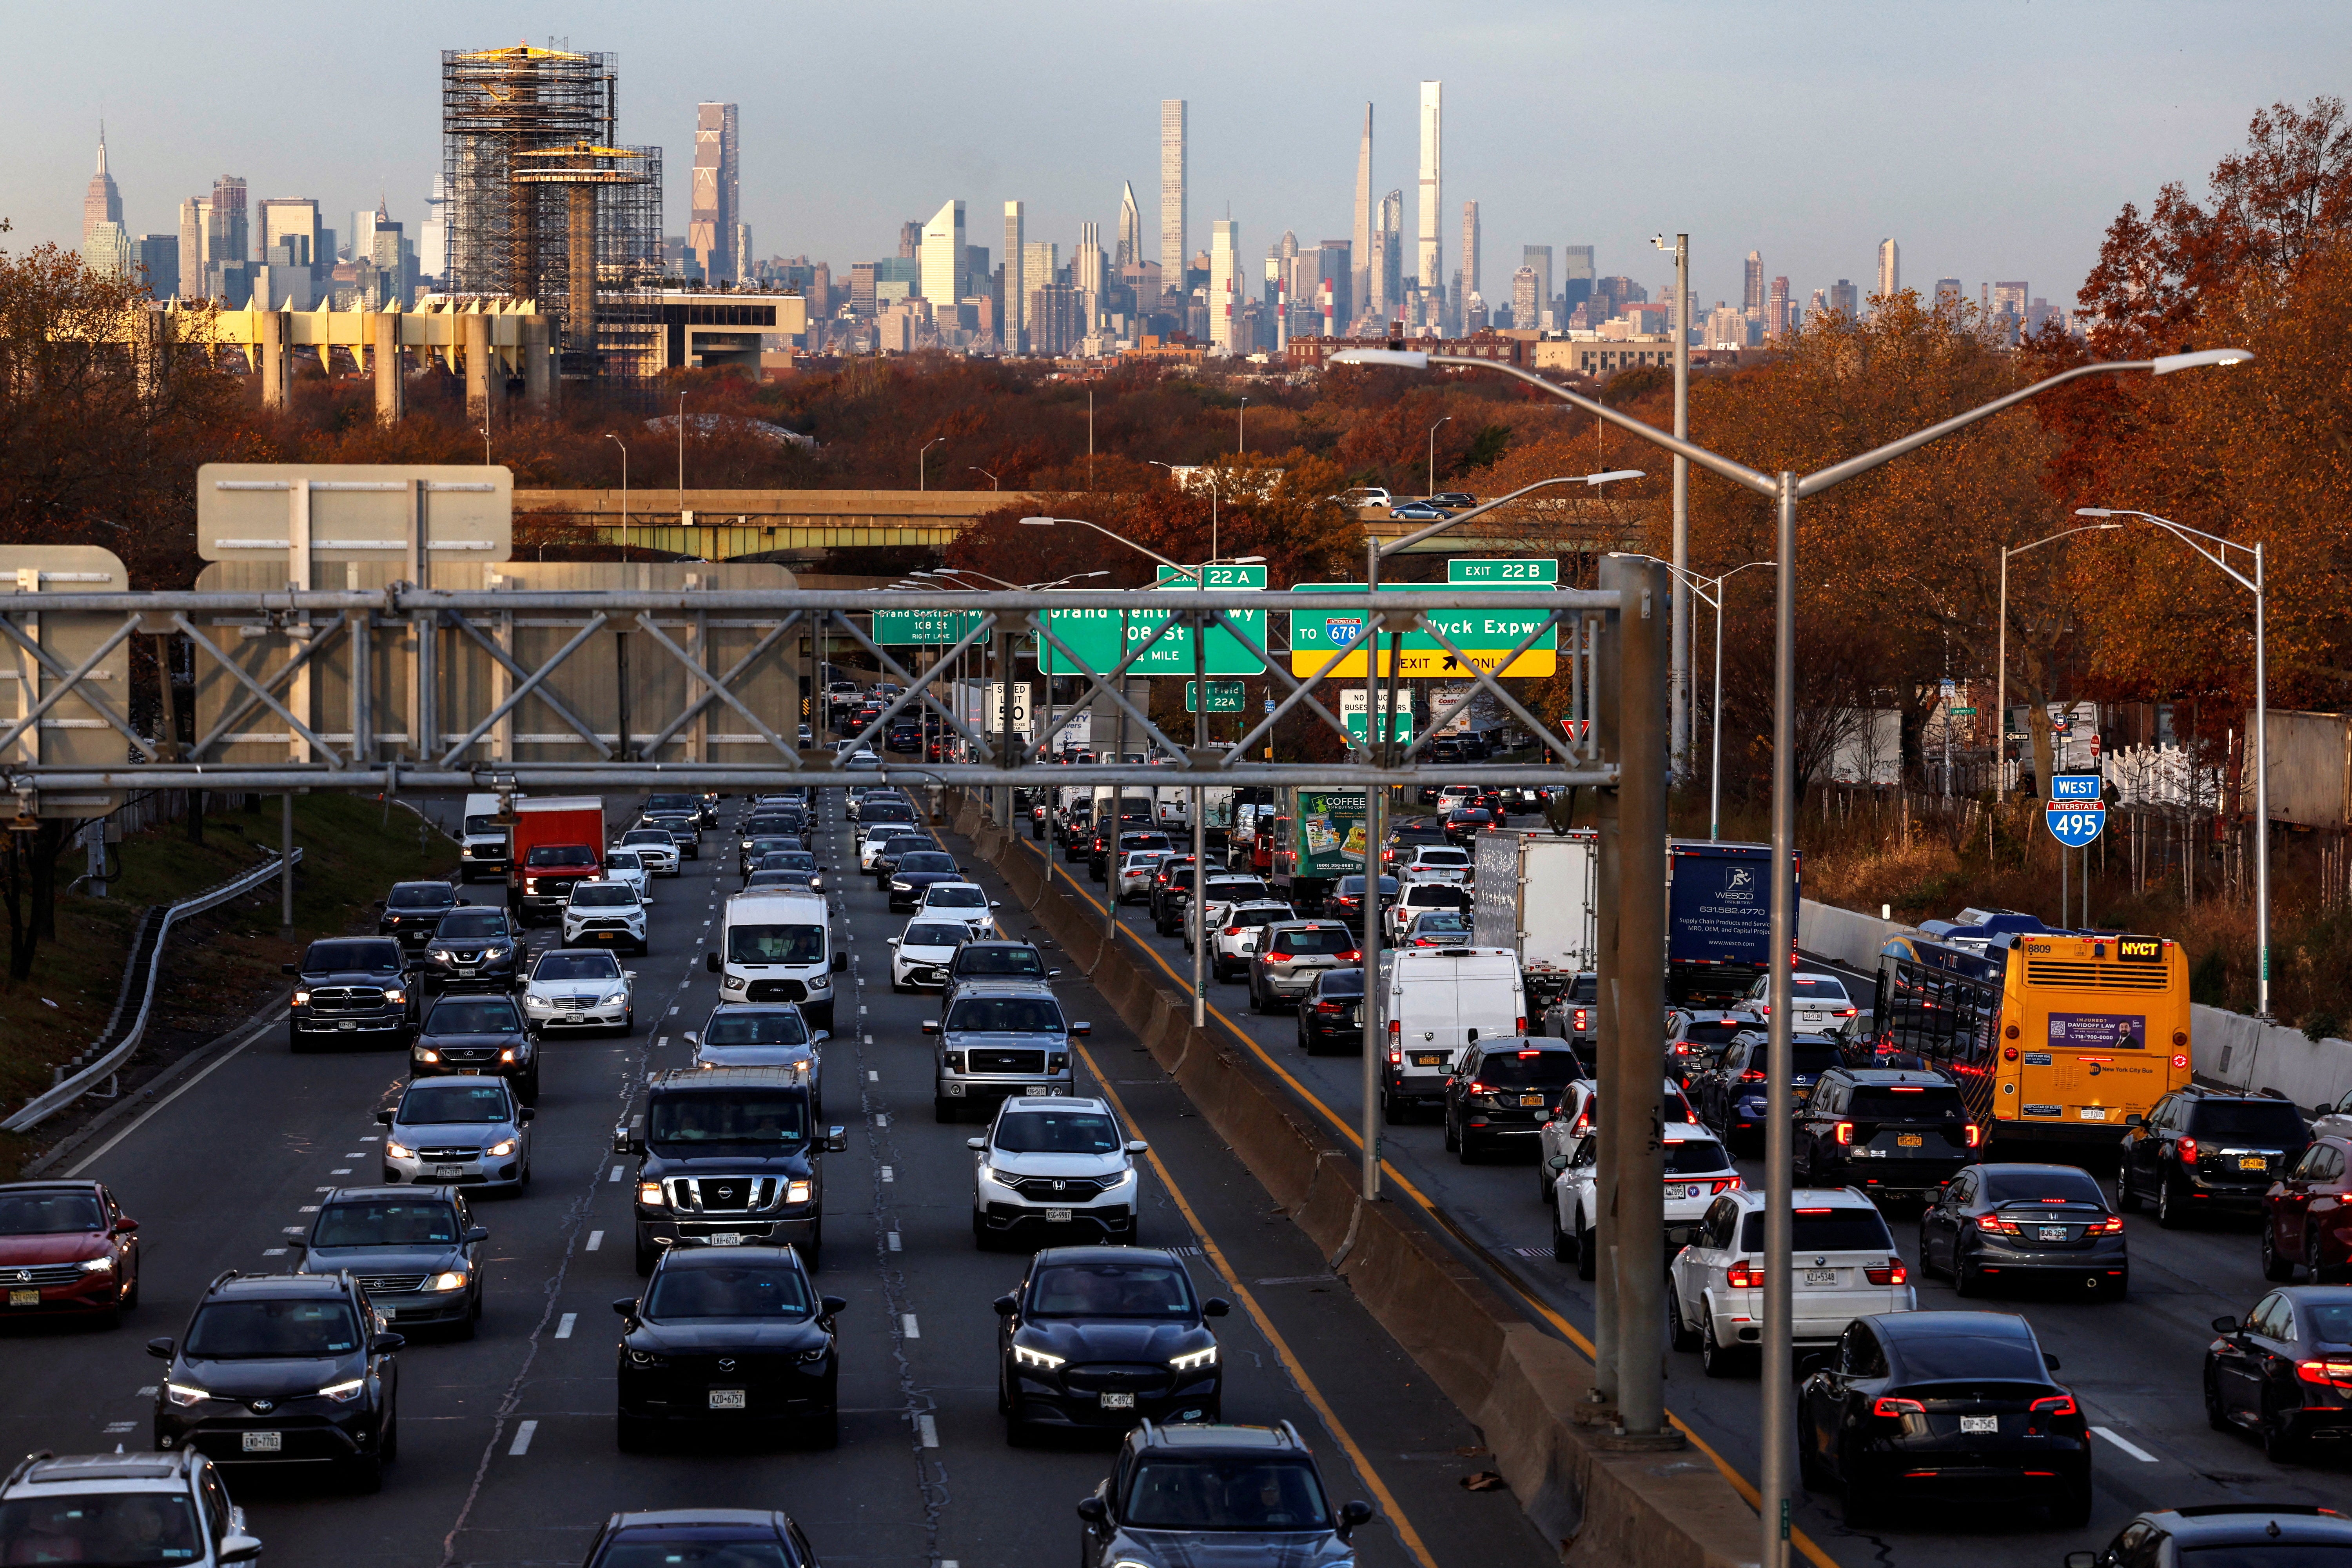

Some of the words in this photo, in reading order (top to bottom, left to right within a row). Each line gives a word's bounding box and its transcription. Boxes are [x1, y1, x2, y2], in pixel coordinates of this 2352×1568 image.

[1466, 566, 1491, 575] EXIT
[1503, 564, 1524, 577] 22
[1529, 564, 1540, 577] B
[1210, 571, 1232, 583] 22
[1238, 571, 1250, 583] A
[1164, 627, 1184, 640] St
[1299, 629, 1317, 639] TO
[1332, 626, 1356, 639] 678
[1152, 652, 1179, 660] MILE
[1401, 658, 1430, 668] EXIT
[2059, 781, 2094, 793] WEST
[1326, 797, 1366, 806] COFFEE
[2056, 815, 2096, 835] 495
[1700, 906, 1765, 915] 631.582.4770
[2028, 944, 2051, 953] 8809
[2122, 942, 2158, 956] NYCT
